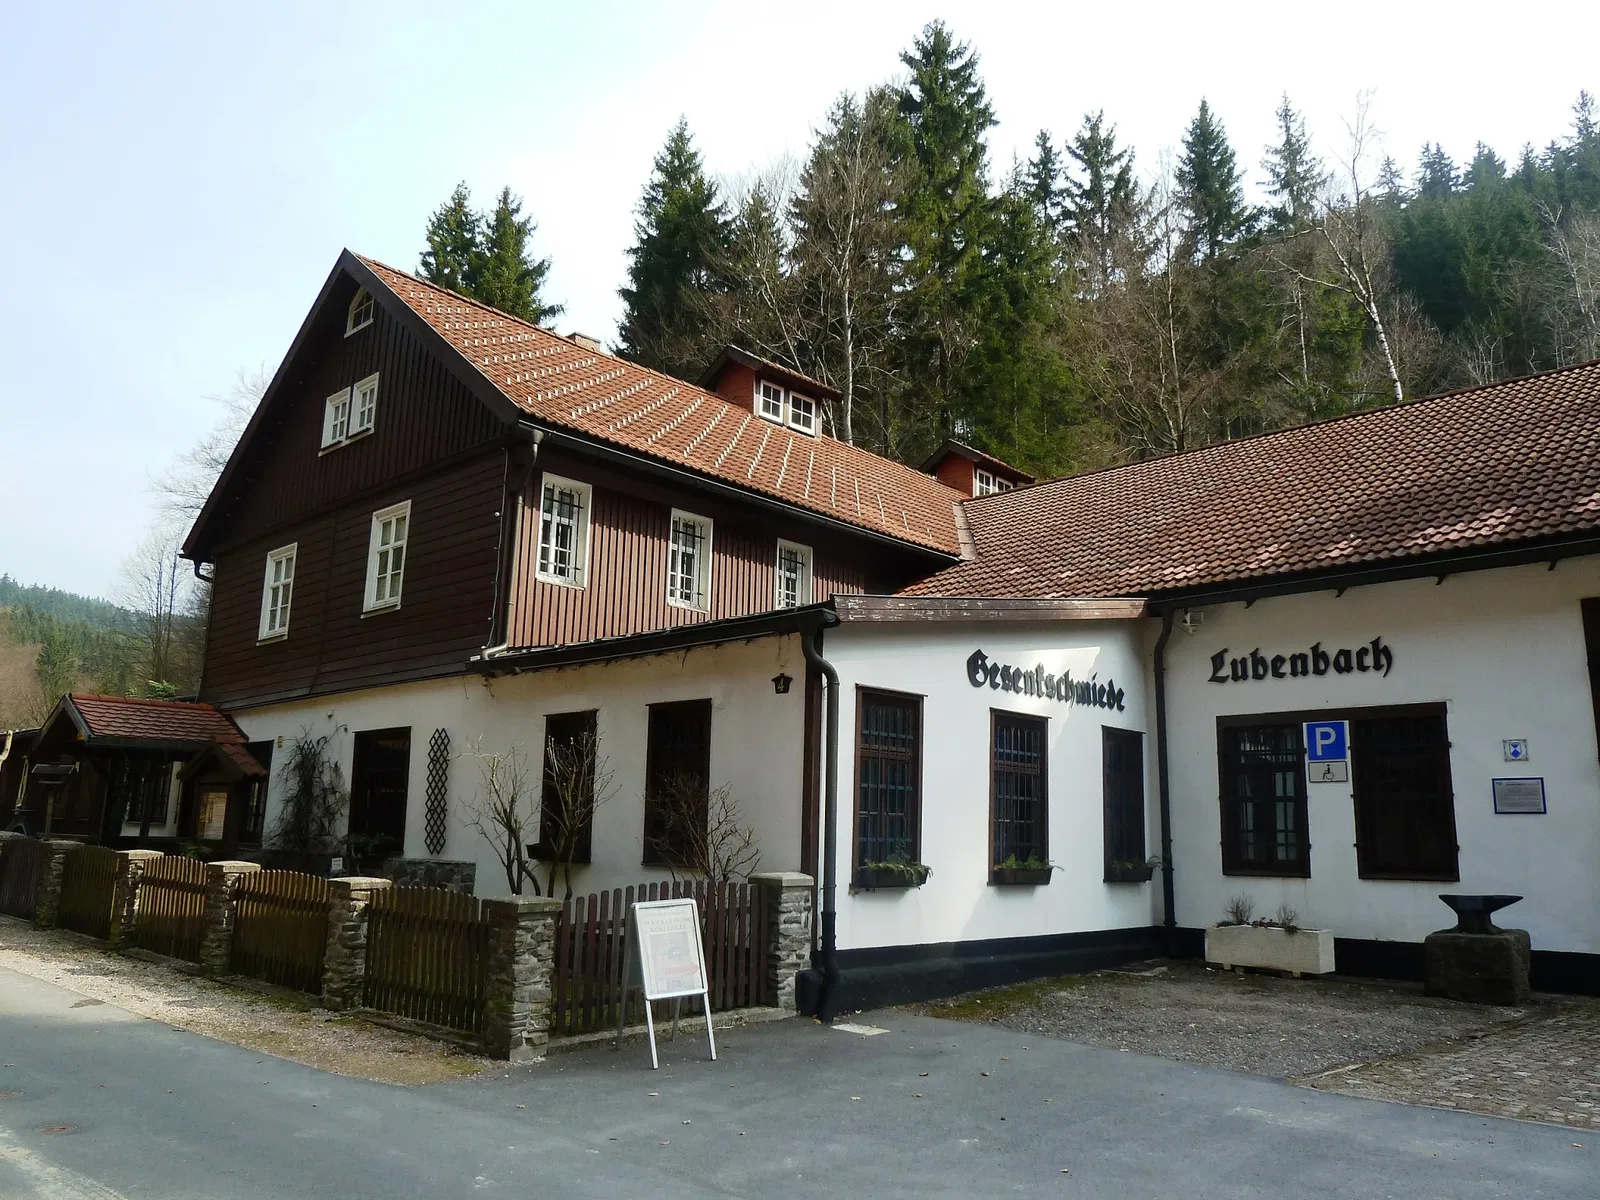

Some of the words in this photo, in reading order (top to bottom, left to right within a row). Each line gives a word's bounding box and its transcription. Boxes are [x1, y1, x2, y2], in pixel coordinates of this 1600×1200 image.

[1208, 636, 1393, 684] Lubenbach
[777, 677, 785, 693] 4
[967, 648, 1125, 711] Gesenkschmiede
[1315, 727, 1336, 756] P
